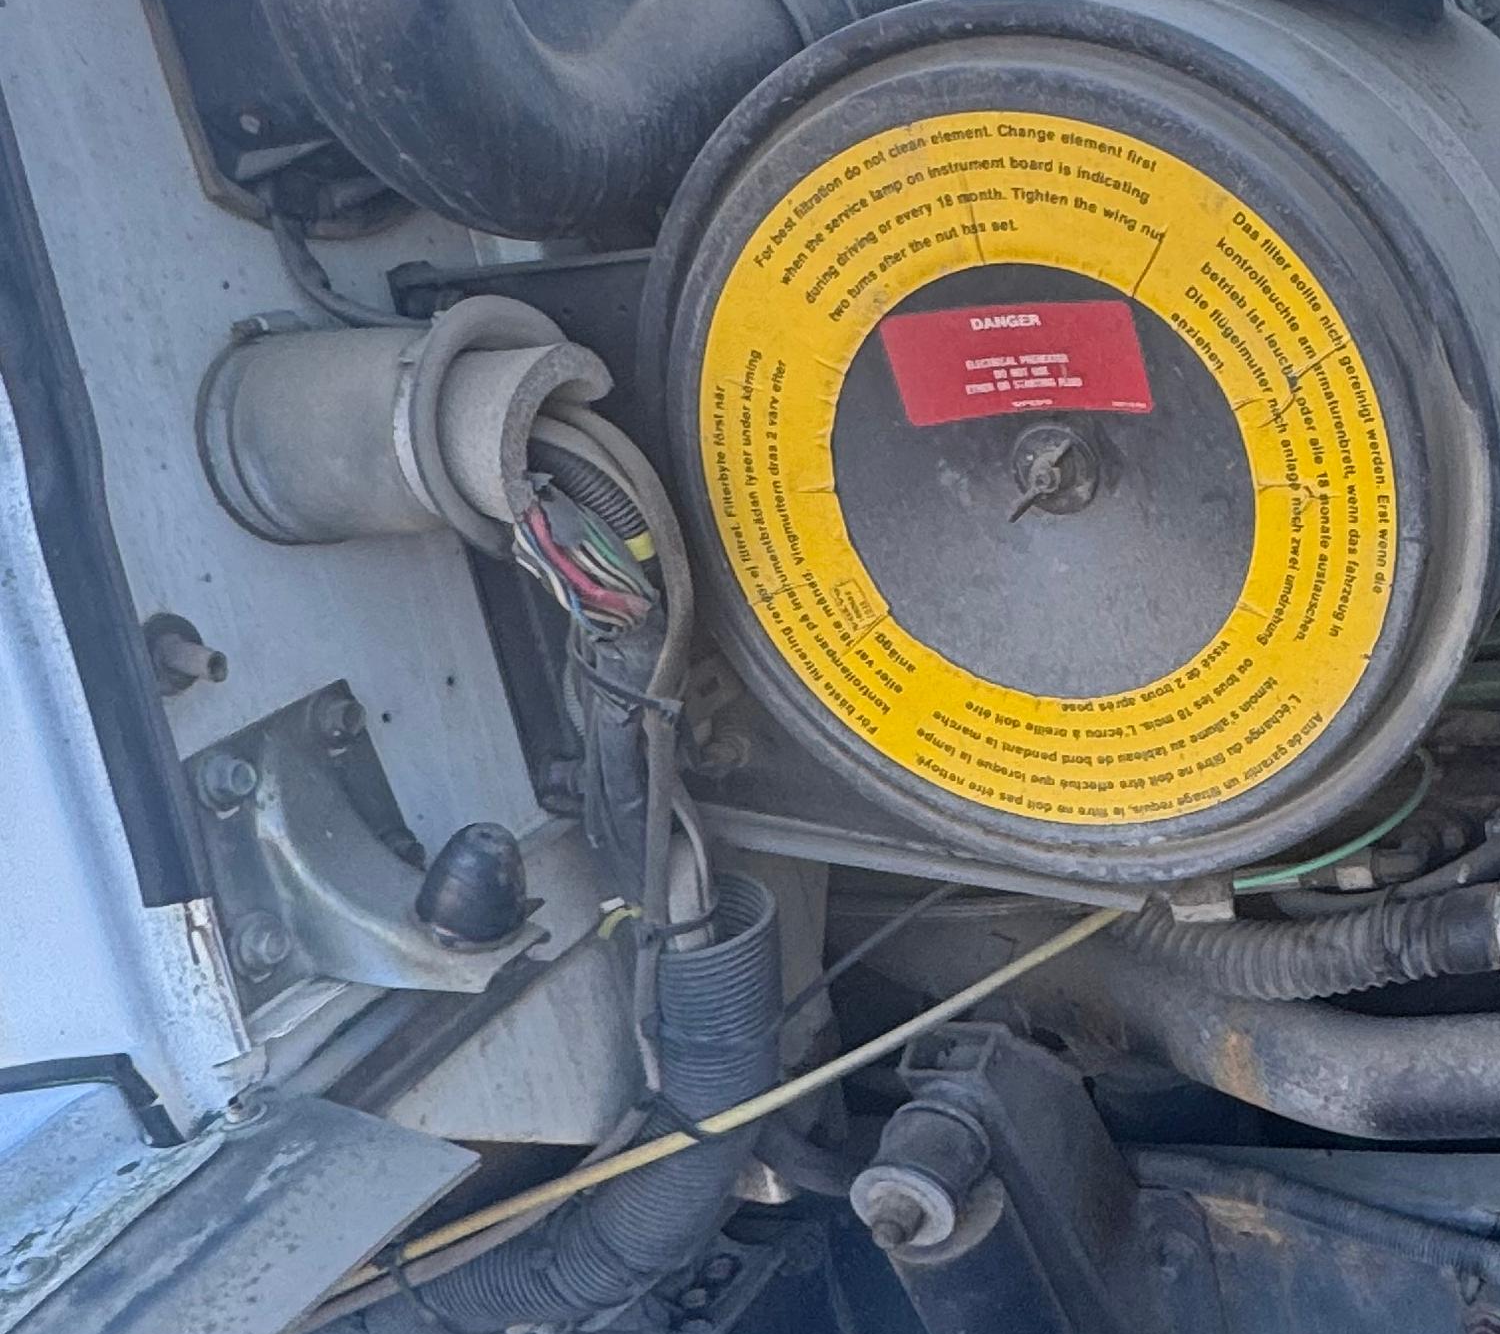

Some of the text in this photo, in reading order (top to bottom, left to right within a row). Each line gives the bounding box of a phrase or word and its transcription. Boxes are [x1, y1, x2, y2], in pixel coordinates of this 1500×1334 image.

[752, 123, 1157, 268] For best filtration do not clean element. Change element first
[780, 156, 1150, 285] when the service lamp on instrument board is indicating
[1231, 211, 1260, 241] Das
[805, 264, 840, 304] during
[836, 230, 878, 267] driving
[877, 219, 892, 235] or
[894, 203, 932, 225] every
[936, 193, 953, 208] 18
[1010, 186, 1068, 205] Tighten
[1073, 196, 1097, 214] the
[1102, 207, 1137, 232] wing
[1140, 224, 1166, 246] nut
[1260, 238, 1292, 271] filter
[828, 298, 850, 322] two
[878, 248, 907, 273] after
[907, 236, 932, 253] the
[934, 226, 959, 243] nut
[960, 218, 986, 235] has
[1184, 285, 1209, 310] Die
[1200, 261, 1247, 309] betrieb
[1289, 273, 1321, 312] sollte
[970, 314, 1042, 331] DANGER
[1319, 315, 1347, 352] nicht
[1297, 335, 1317, 360] am
[770, 359, 786, 393] efter
[1264, 333, 1303, 395] leucht
[713, 384, 725, 410] när
[1337, 355, 1375, 423] gereinigt
[767, 395, 779, 426] varv
[1293, 396, 1317, 431] oder
[712, 413, 725, 447] först
[739, 405, 752, 447] under
[765, 430, 778, 440] 2
[767, 444, 780, 476] dras
[1280, 438, 1301, 491] anlage
[1308, 437, 1325, 465] alle
[716, 451, 737, 518] Filterbyte
[1316, 471, 1330, 488] 18
[1346, 484, 1359, 524] wenn
[1376, 494, 1390, 524] Erst
[1317, 493, 1332, 549] monate
[1287, 536, 1301, 571] zwei
[1347, 528, 1361, 555] das
[1376, 528, 1388, 567] wenn
[744, 565, 759, 579] ej
[1371, 571, 1386, 594] die
[1293, 553, 1328, 641] austauschen.
[1331, 560, 1359, 621] fahrzeug
[798, 613, 819, 631] på
[1256, 574, 1295, 646] umdrehung
[1328, 624, 1343, 638] in
[780, 625, 823, 681] filtrering
[854, 648, 874, 668] var
[1236, 657, 1253, 675] ou
[874, 668, 903, 694] eller
[1173, 676, 1186, 690] 2
[1185, 666, 1201, 681] de
[1212, 673, 1240, 697] tous
[823, 681, 856, 716] bästa
[1060, 698, 1094, 712] pose
[1192, 693, 1215, 710] les
[1238, 676, 1278, 713] témoin
[855, 713, 878, 735] För
[932, 710, 981, 740] marche
[994, 713, 1021, 729] doit
[1176, 706, 1193, 721] 18
[1244, 693, 1301, 745] L'échange
[916, 727, 956, 757] lampe
[984, 736, 998, 749] la
[1117, 745, 1168, 763] tableau
[1169, 738, 1186, 751] au
[1225, 741, 1243, 756] du
[959, 750, 972, 765] la
[1061, 754, 1093, 767] bord
[1096, 754, 1114, 766] de
[1030, 774, 1056, 786] que
[1147, 771, 1174, 787] doit
[1177, 765, 1194, 778] ne
[998, 791, 1024, 806] pas
[1026, 799, 1053, 813] doit
[1056, 803, 1074, 814] ne
